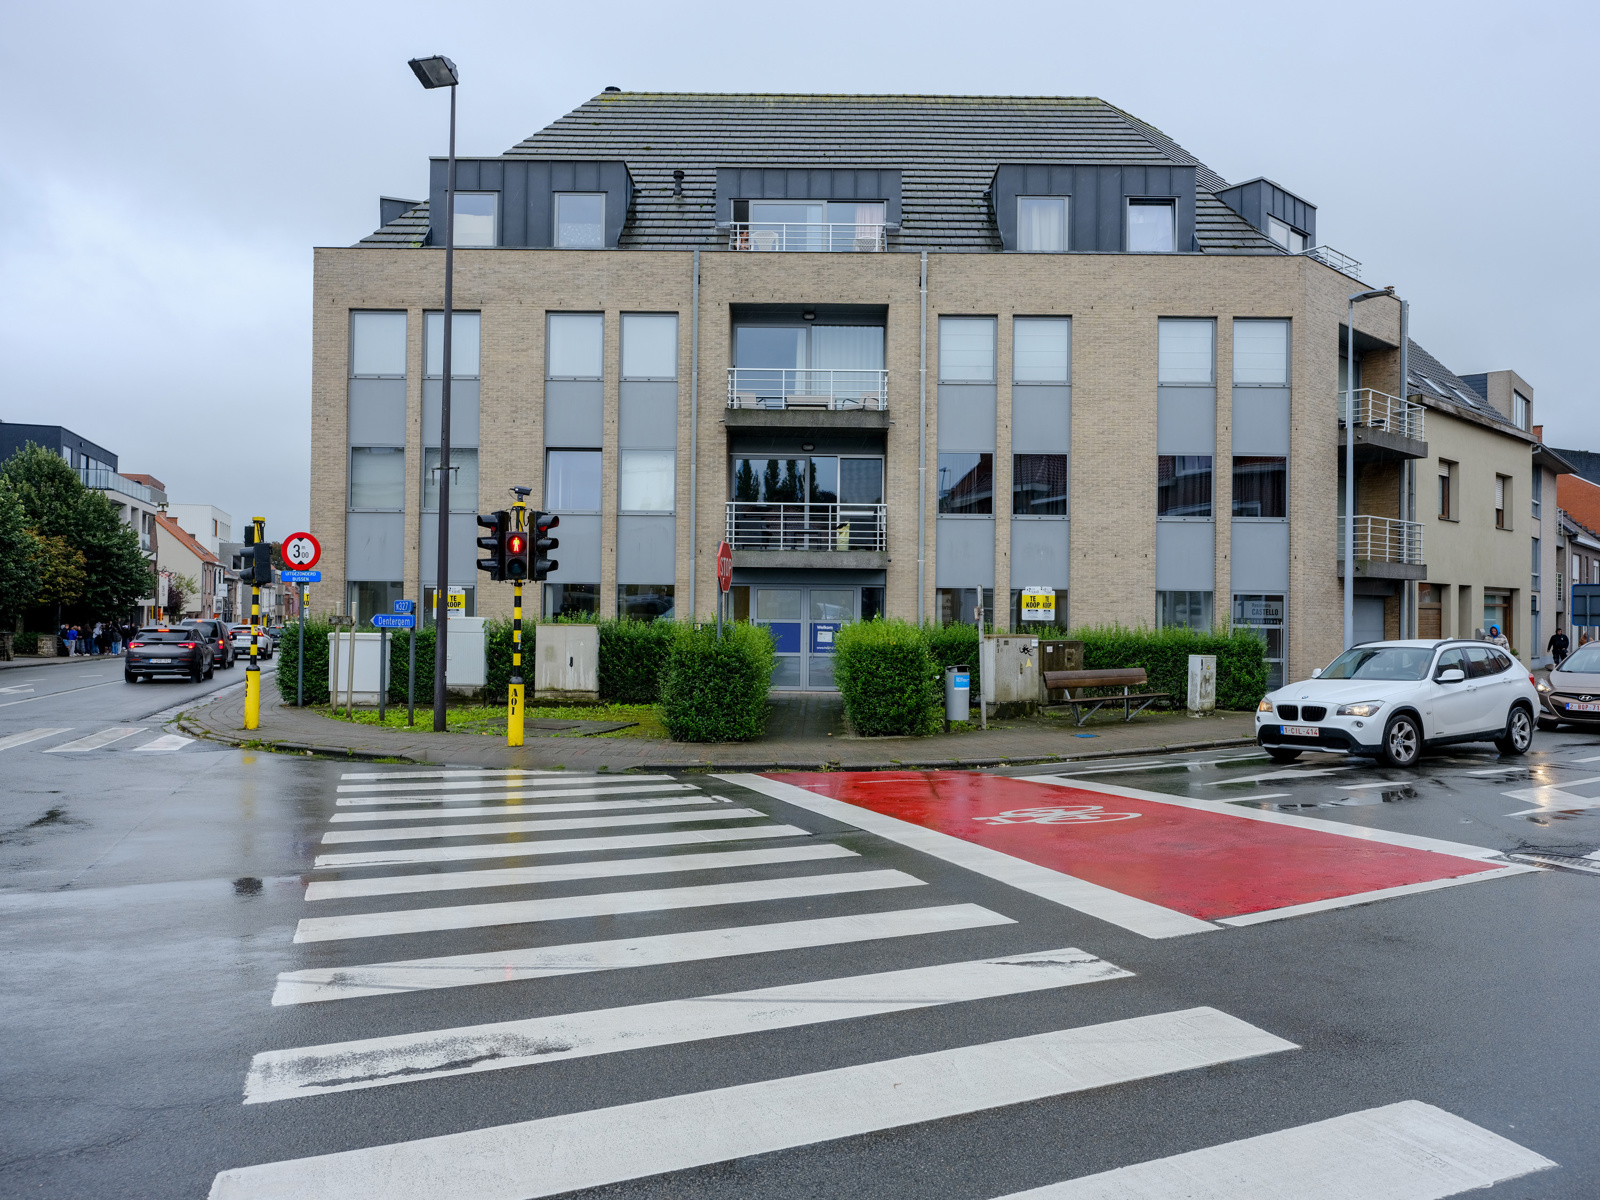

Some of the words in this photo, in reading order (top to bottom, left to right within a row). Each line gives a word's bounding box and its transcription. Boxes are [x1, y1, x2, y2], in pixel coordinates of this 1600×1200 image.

[293, 544, 300, 558] 3
[720, 557, 731, 577] STOP
[379, 617, 410, 626] Dentergem
[1285, 727, 1318, 735] 1-CIL-414
